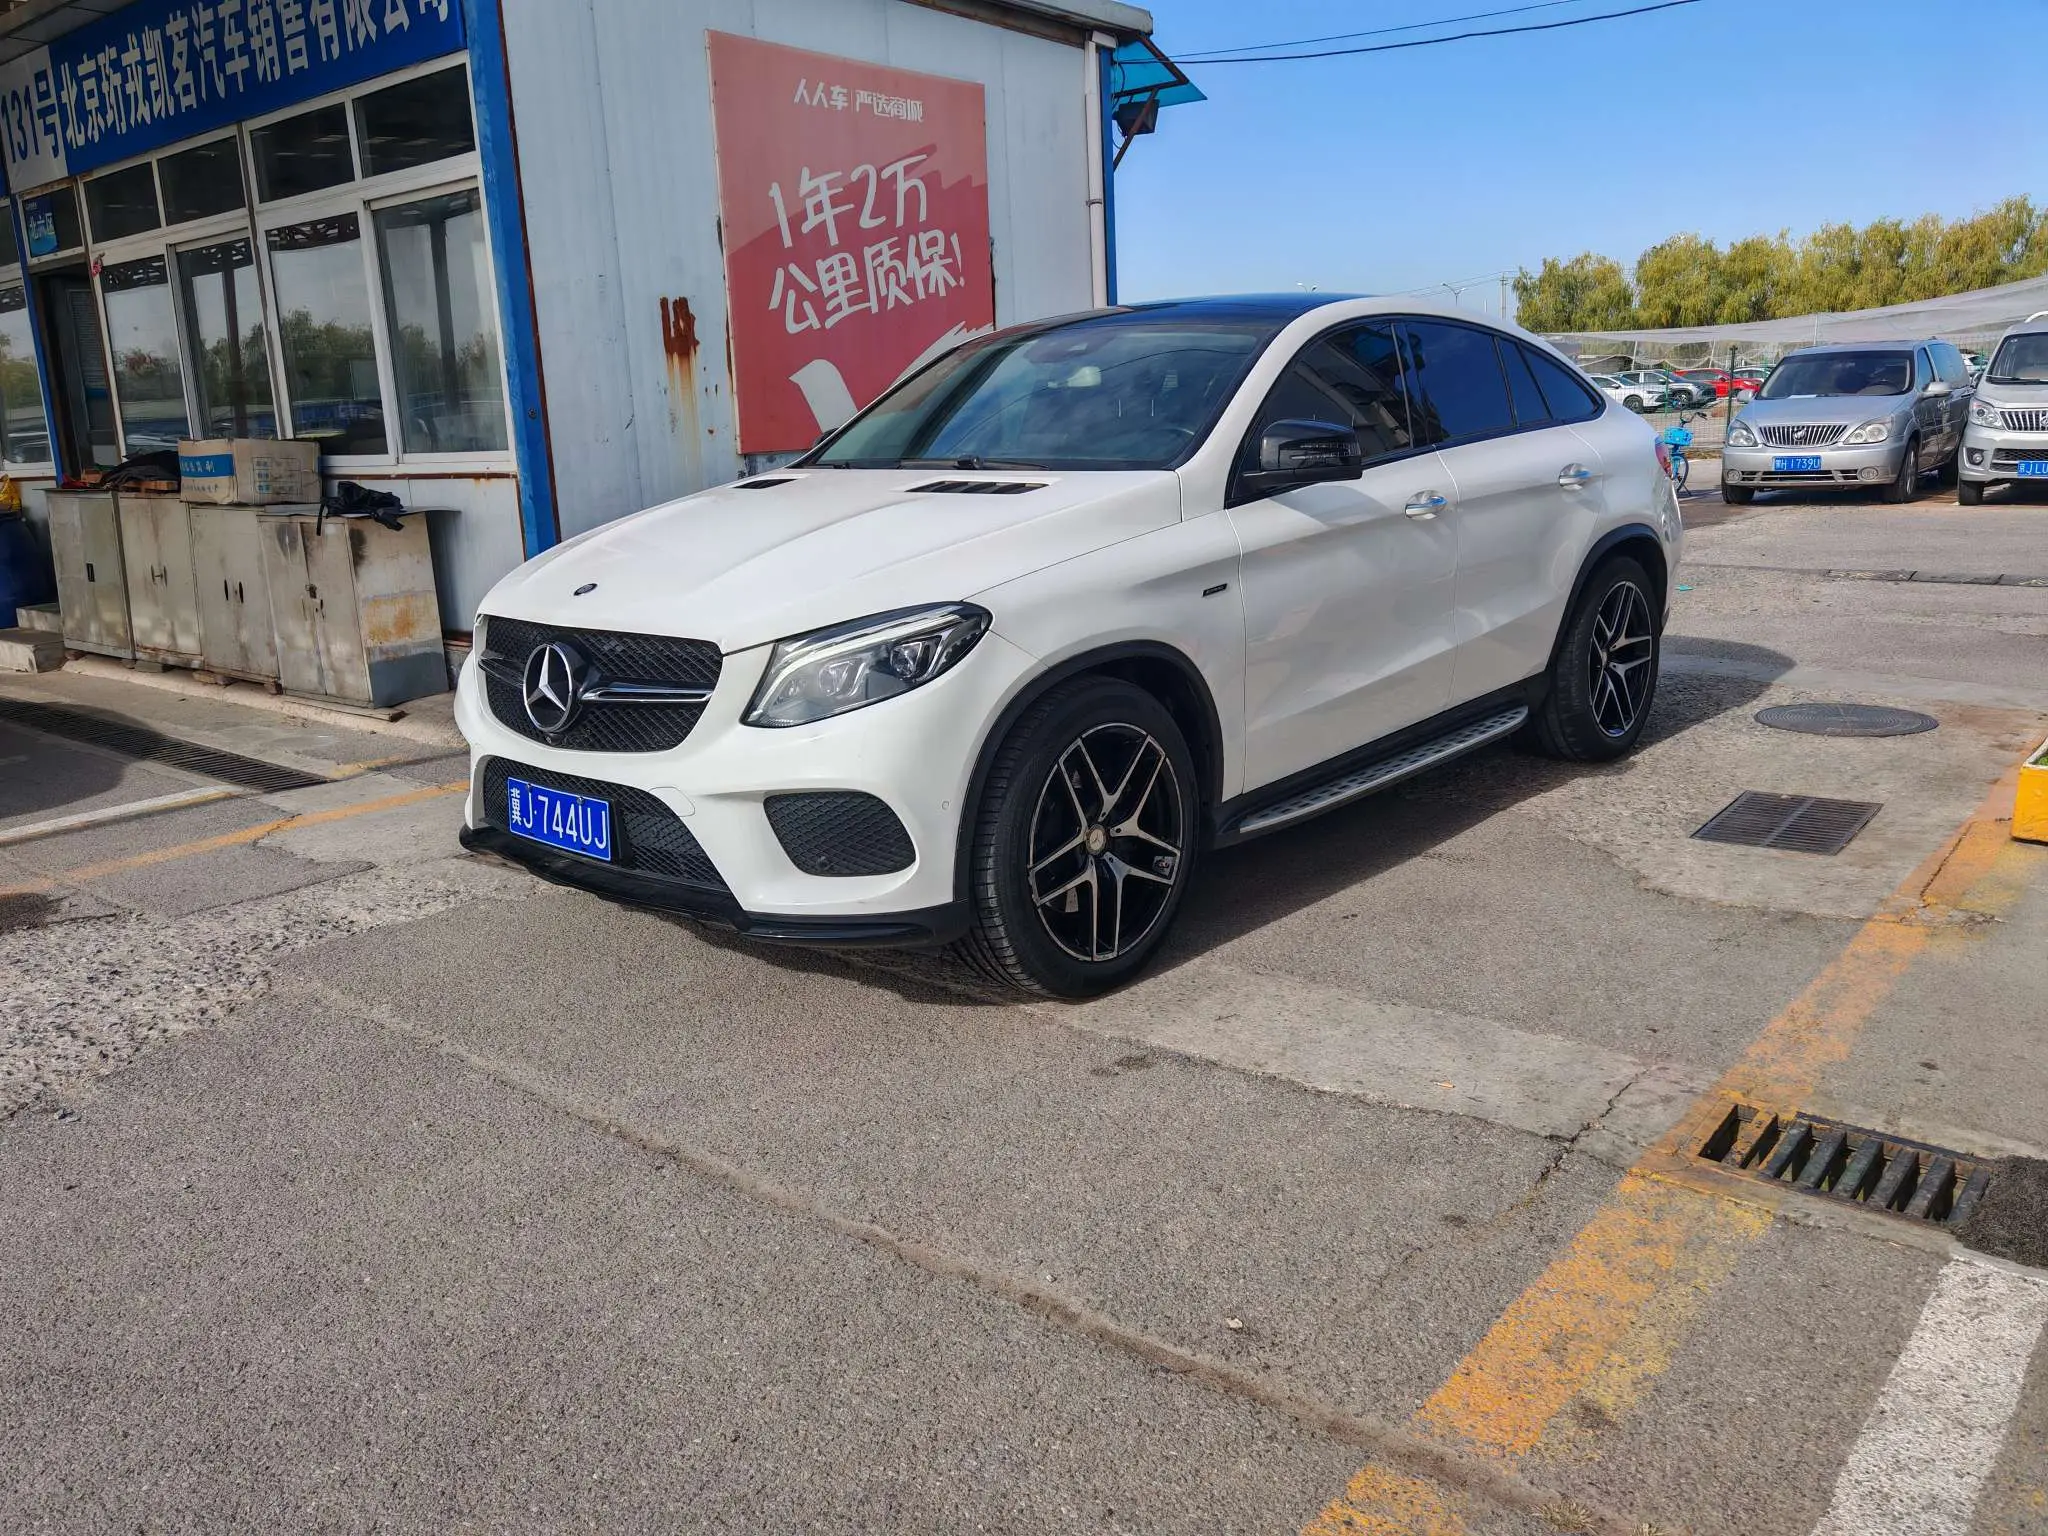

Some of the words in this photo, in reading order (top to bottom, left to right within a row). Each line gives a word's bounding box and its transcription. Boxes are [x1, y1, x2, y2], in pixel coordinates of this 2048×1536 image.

[1, 69, 60, 163] 131号
[794, 78, 848, 111] 人人车
[768, 154, 928, 249] 1年2万
[768, 229, 965, 334] 公里质保!
